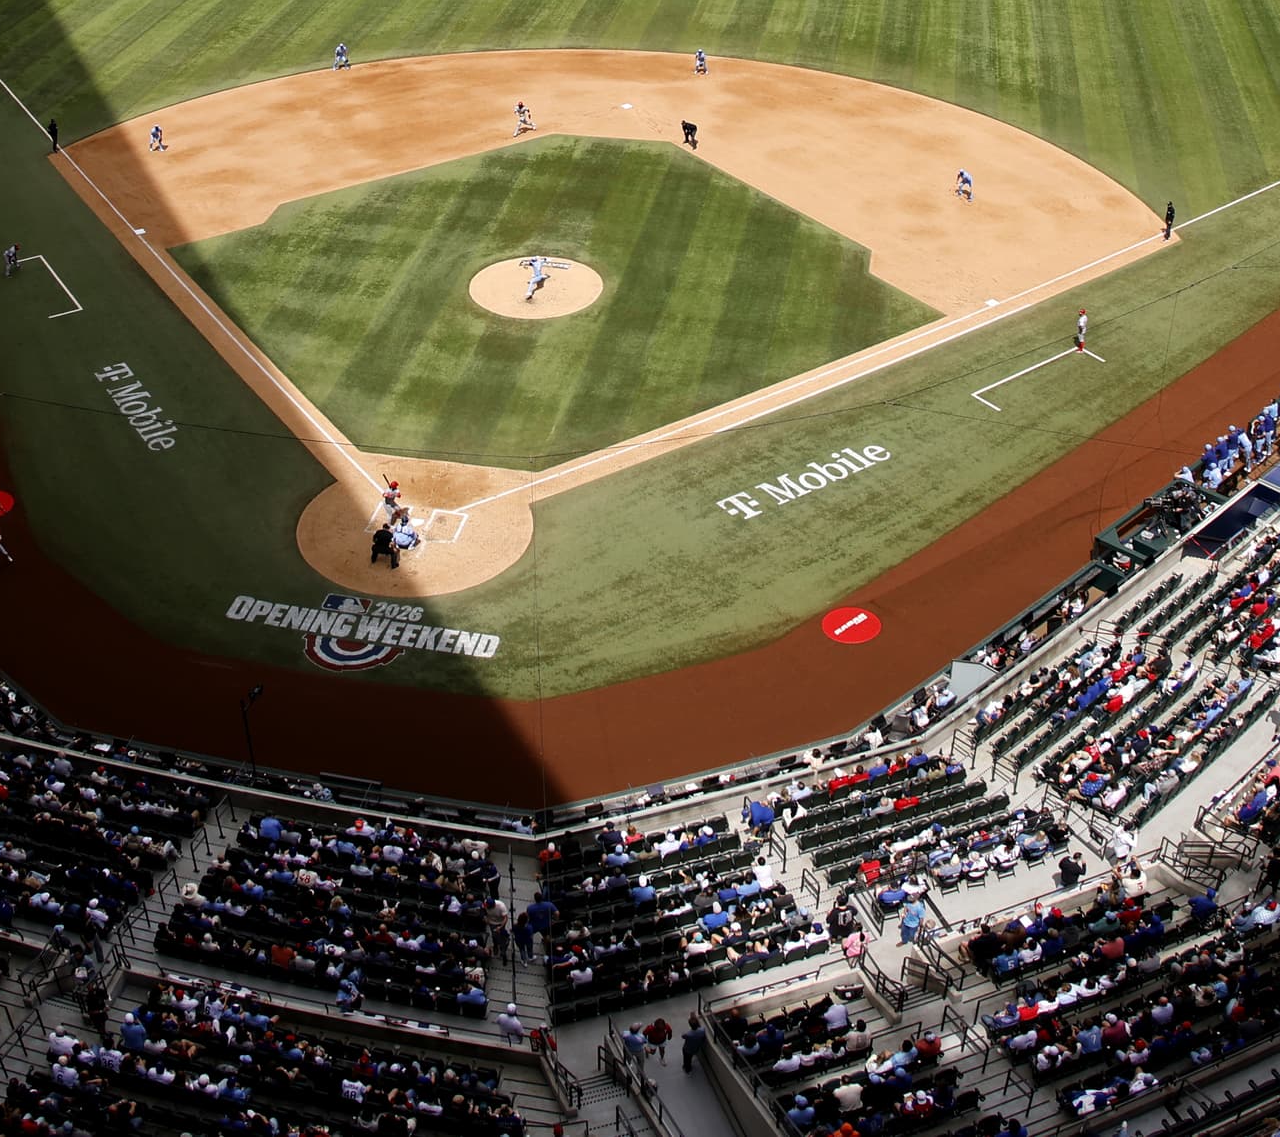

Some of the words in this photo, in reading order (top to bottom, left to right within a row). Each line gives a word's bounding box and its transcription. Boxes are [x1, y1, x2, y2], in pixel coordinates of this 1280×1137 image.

[112, 378, 177, 453] Mobile
[762, 439, 891, 507] Mobile
[225, 595, 357, 639] OPENING
[355, 614, 500, 659] WEEKEND
[370, 601, 424, 621] 2026
